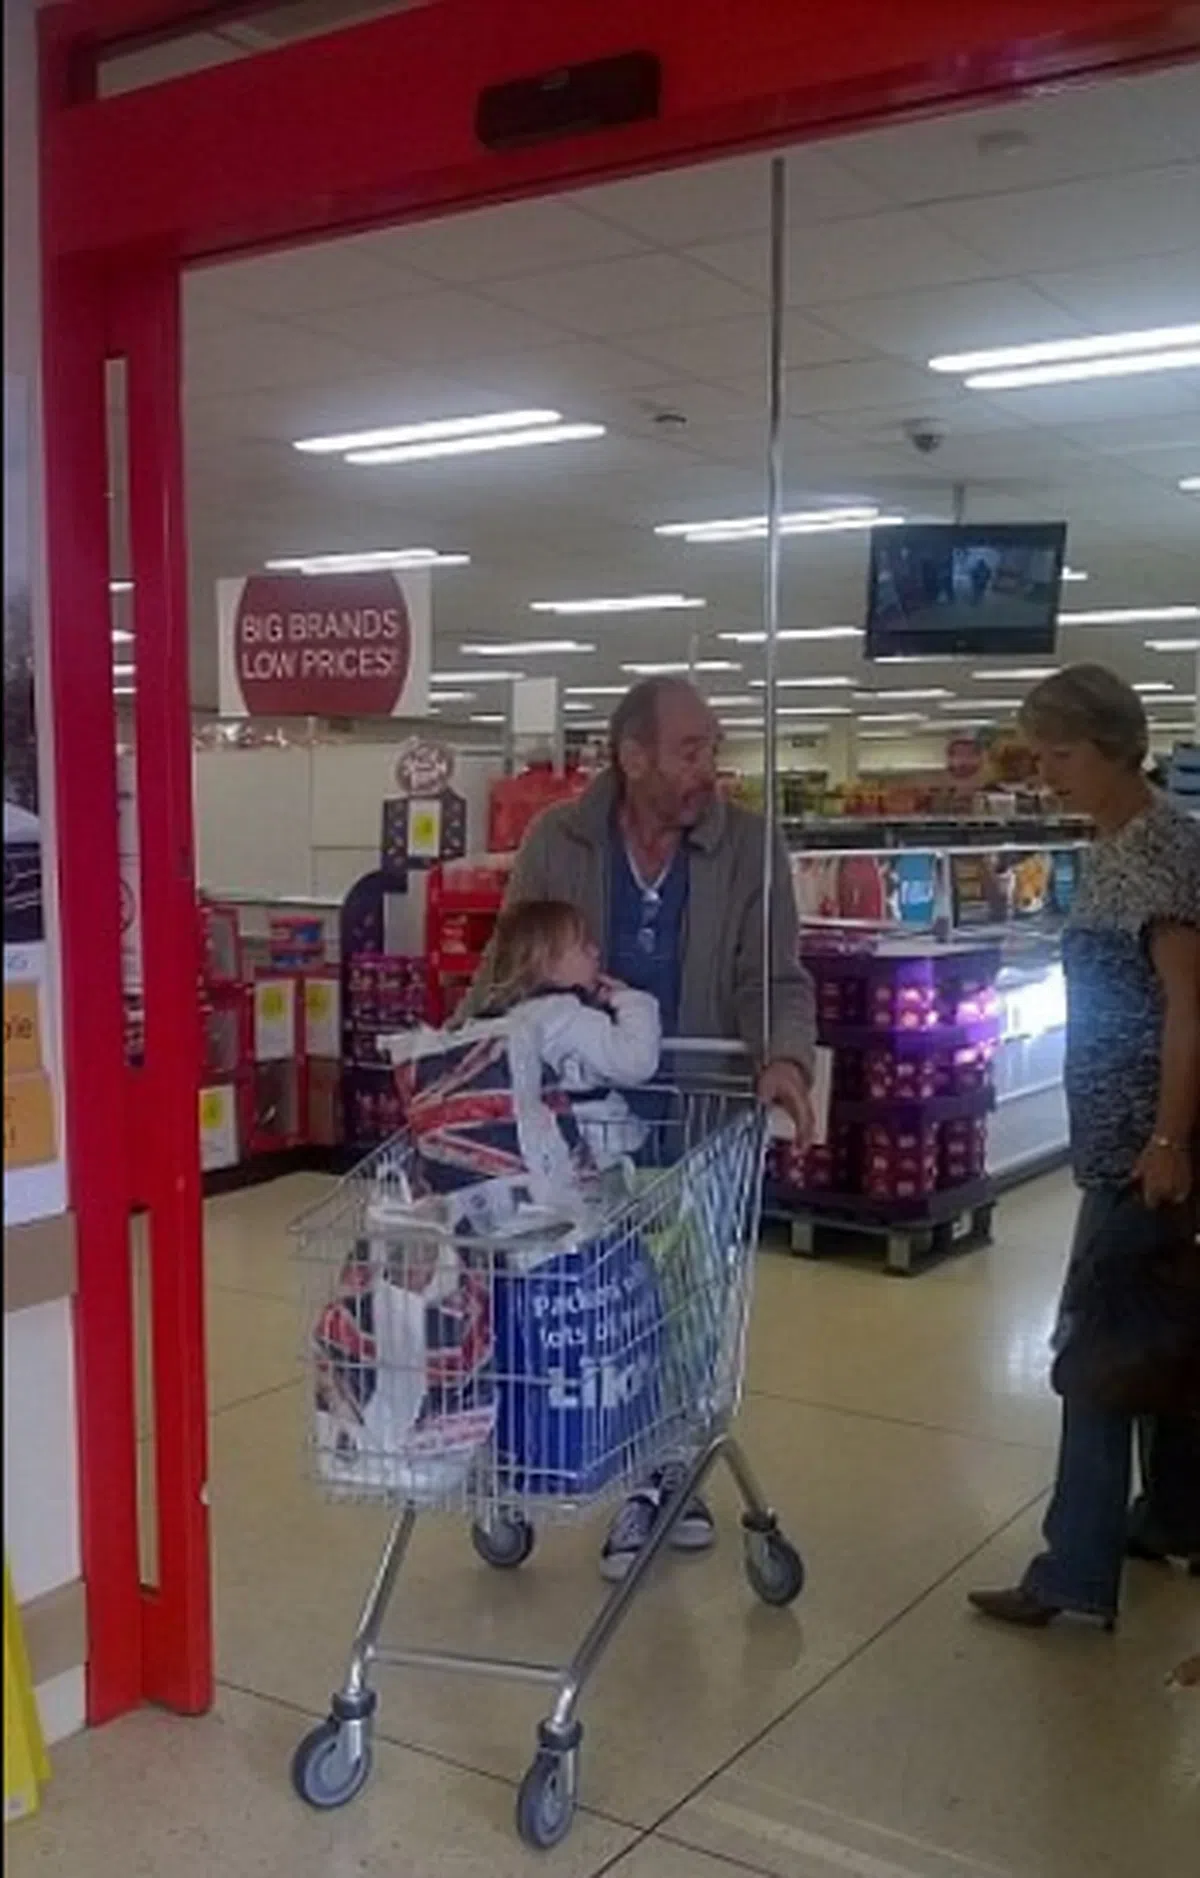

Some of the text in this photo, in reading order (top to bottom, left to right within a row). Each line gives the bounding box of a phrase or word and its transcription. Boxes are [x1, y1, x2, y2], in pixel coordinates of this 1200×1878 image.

[242, 608, 398, 643] BIG BRANDS
[242, 650, 297, 681] LOW
